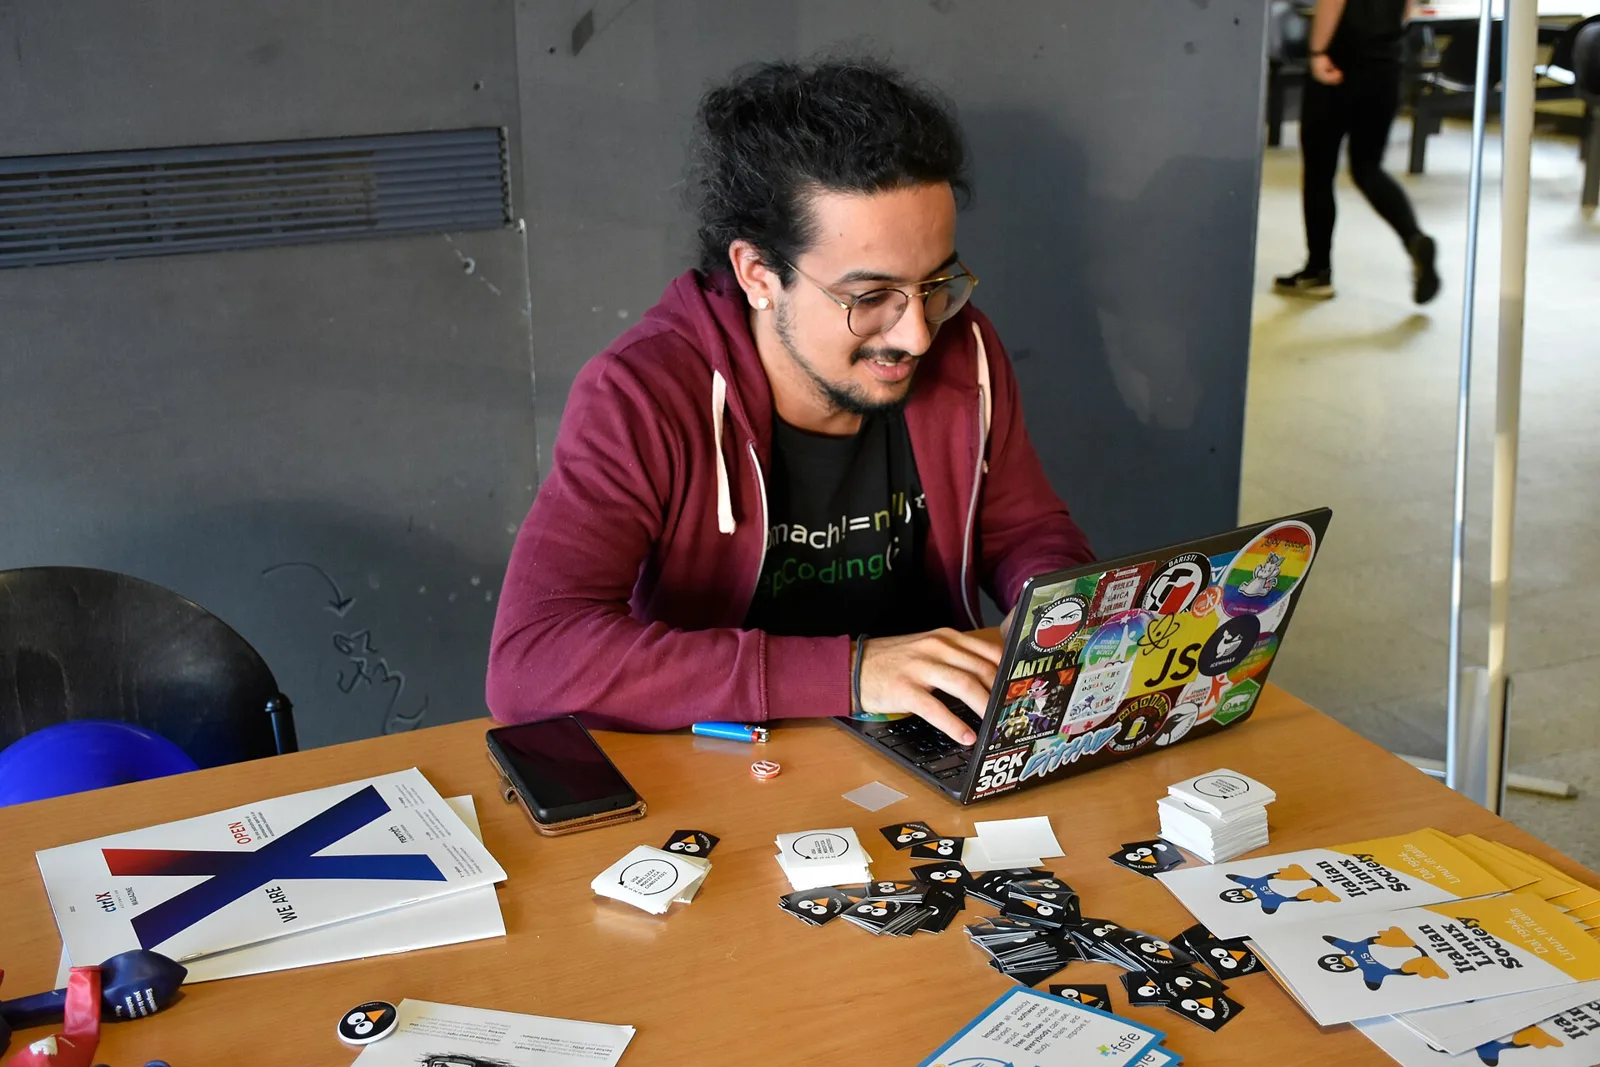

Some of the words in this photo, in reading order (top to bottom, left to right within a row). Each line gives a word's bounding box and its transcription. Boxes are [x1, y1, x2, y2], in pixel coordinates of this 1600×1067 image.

[1144, 643, 1202, 687] JS
[980, 750, 1027, 777] FCK
[228, 821, 252, 844] OPEN
[1403, 843, 1428, 862] Italia
[1424, 858, 1437, 867] in
[1316, 861, 1367, 897] Italian
[1338, 859, 1385, 892] Linux
[1352, 853, 1411, 892] Society
[1418, 868, 1435, 880] Dal
[1436, 865, 1460, 884] Linux
[265, 885, 292, 907] ARE
[278, 905, 297, 924] WE
[1510, 907, 1539, 928] Italia
[1534, 925, 1550, 937] in
[1418, 924, 1477, 973] Italian
[1441, 923, 1496, 967] Linux
[1456, 916, 1524, 969] Society
[1529, 939, 1549, 955] Dal
[1547, 935, 1576, 961] Linux
[1360, 952, 1377, 965] ILS
[1017, 1003, 1040, 1021] software
[981, 1021, 1005, 1038] Imagine
[1110, 1032, 1140, 1053] fsfe
